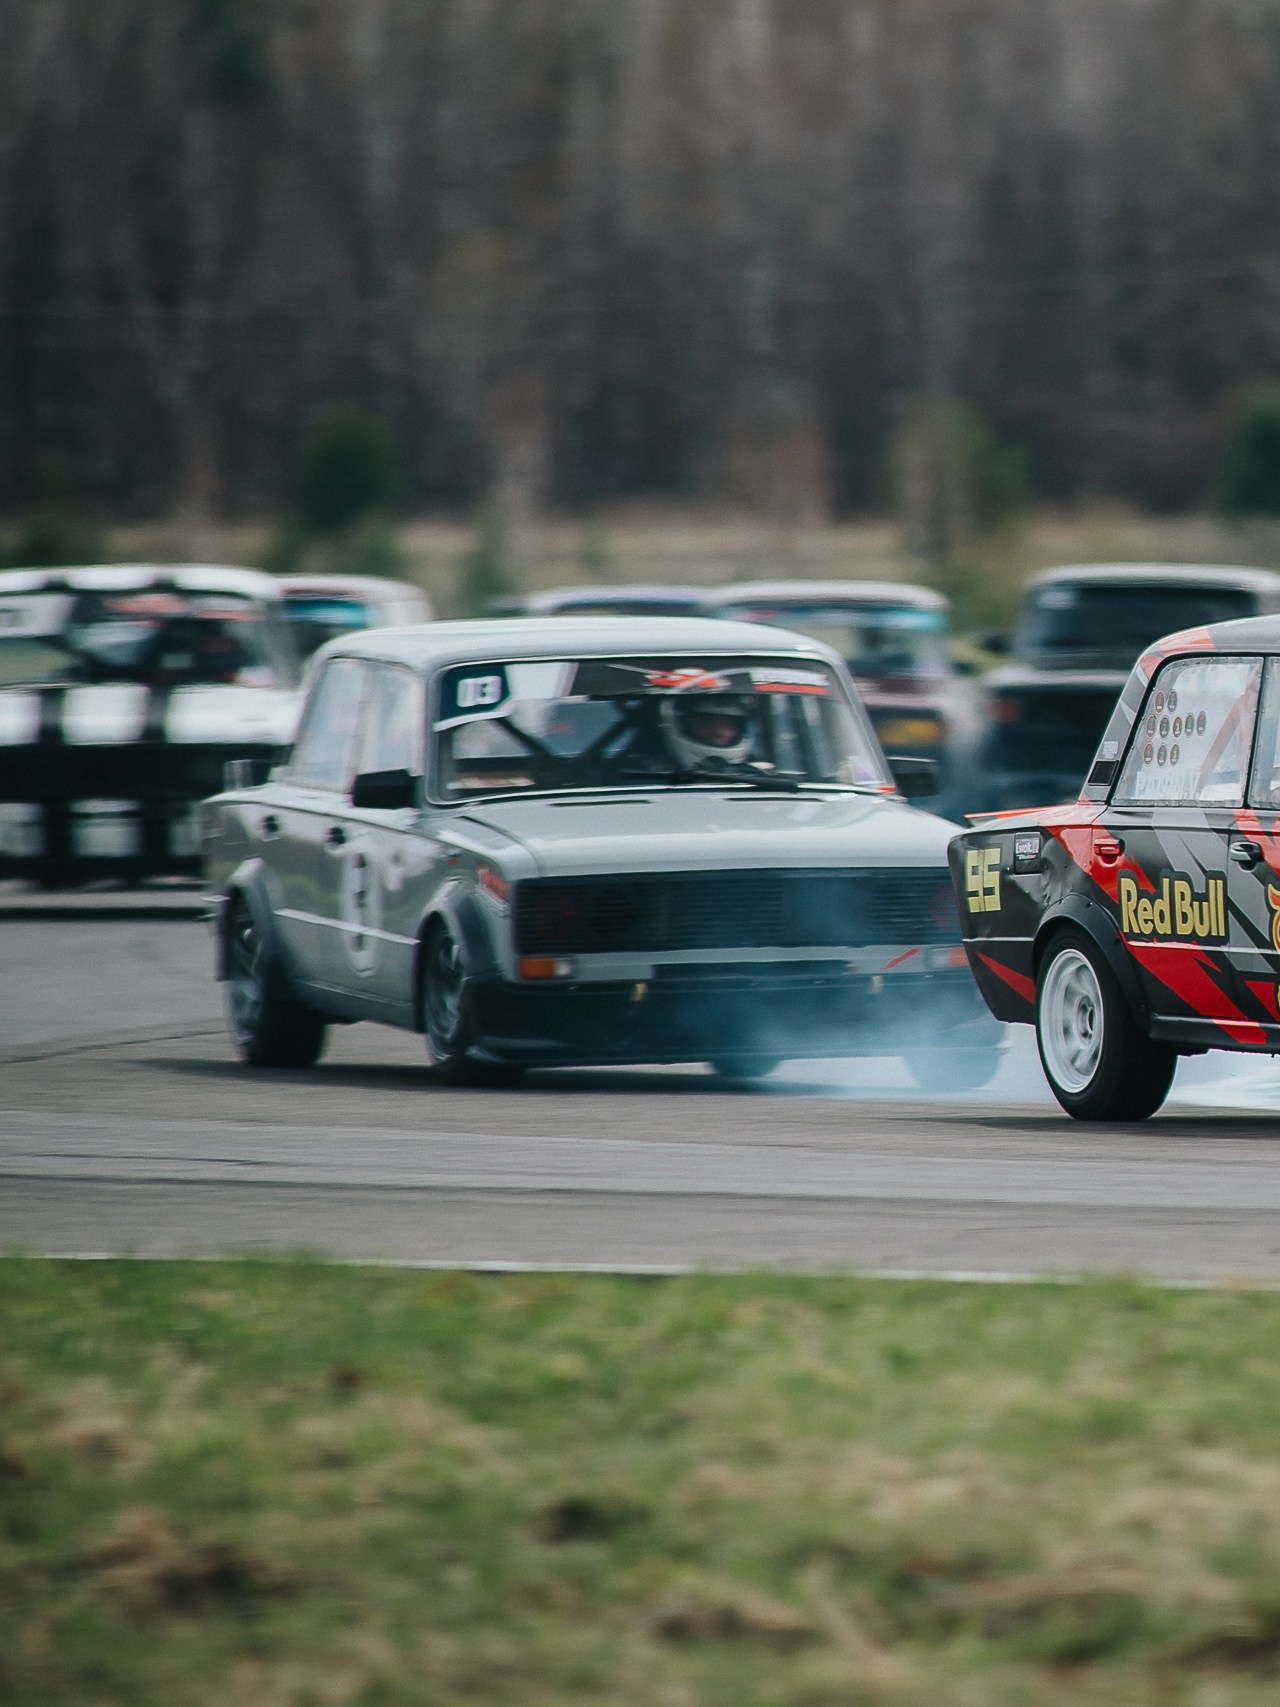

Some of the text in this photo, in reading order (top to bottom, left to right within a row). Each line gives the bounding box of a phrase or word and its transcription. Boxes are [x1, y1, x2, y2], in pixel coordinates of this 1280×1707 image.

[967, 848, 1001, 913] 95
[1121, 878, 1225, 936] Red Bull
